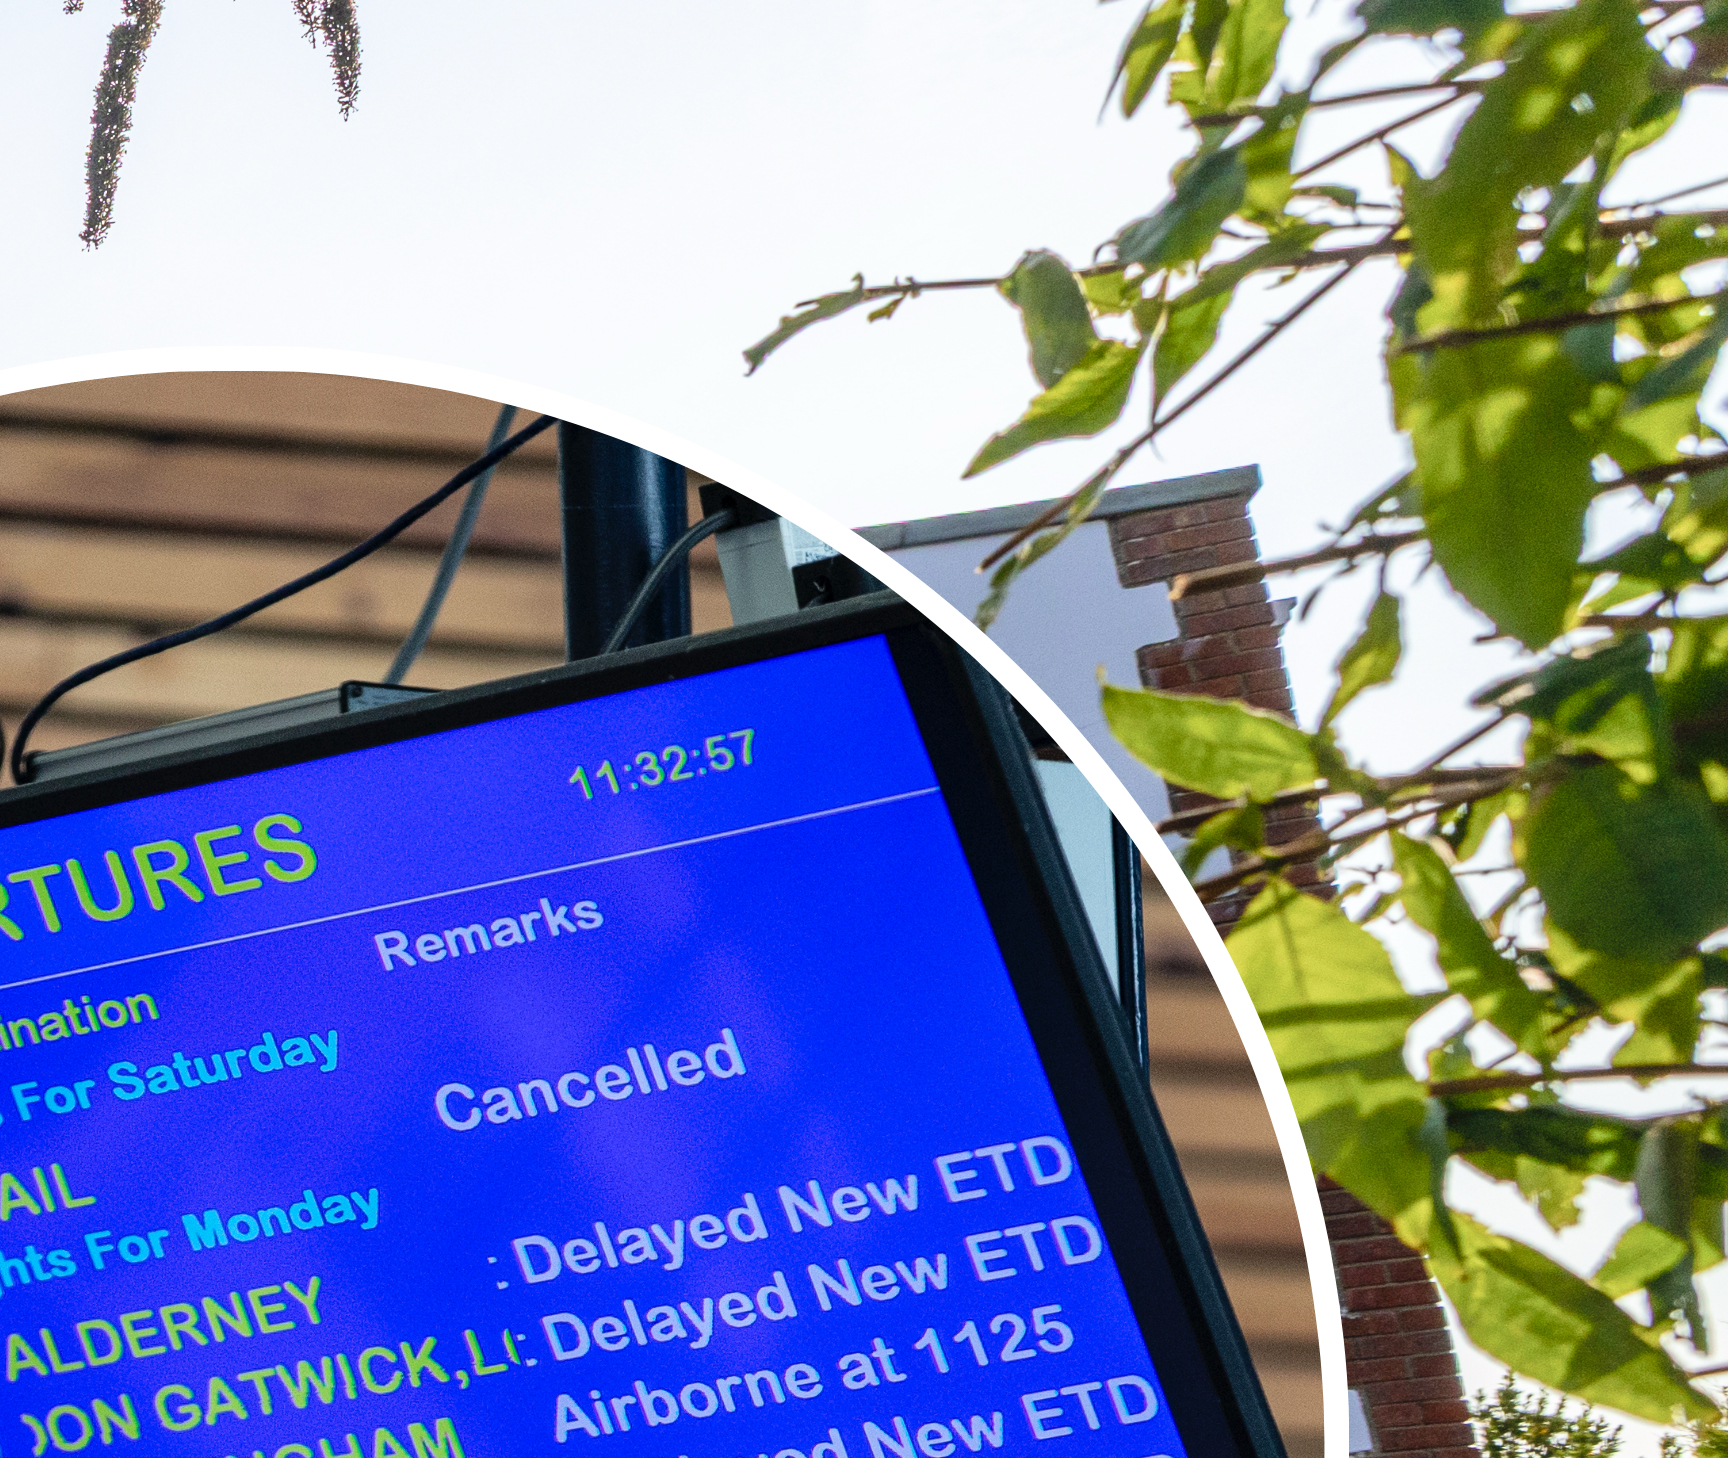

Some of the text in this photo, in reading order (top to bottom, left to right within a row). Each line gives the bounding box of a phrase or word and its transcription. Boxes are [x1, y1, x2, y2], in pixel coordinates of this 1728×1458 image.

[568, 728, 756, 801] 11:32:57
[373, 895, 605, 972] Remarks
[11, 1075, 96, 1122] For
[108, 1030, 340, 1101] Saturday
[434, 1026, 748, 1132] Cancelled
[6, 1275, 322, 1382] ALDERNEY
[512, 1192, 770, 1290] Delayed
[777, 1174, 919, 1233] New
[935, 1136, 1074, 1203] ETD
[85, 1224, 169, 1270] For
[181, 1187, 381, 1252] Monday
[153, 1328, 522, 1433] GATWICK,L
[541, 1269, 799, 1362] Delayed
[806, 1252, 949, 1312] New
[965, 1215, 1103, 1282] ETD
[554, 1362, 824, 1444] Airborne
[838, 1336, 908, 1391] at
[914, 1303, 1075, 1374] 1125
[1021, 1374, 1159, 1441] ETD
